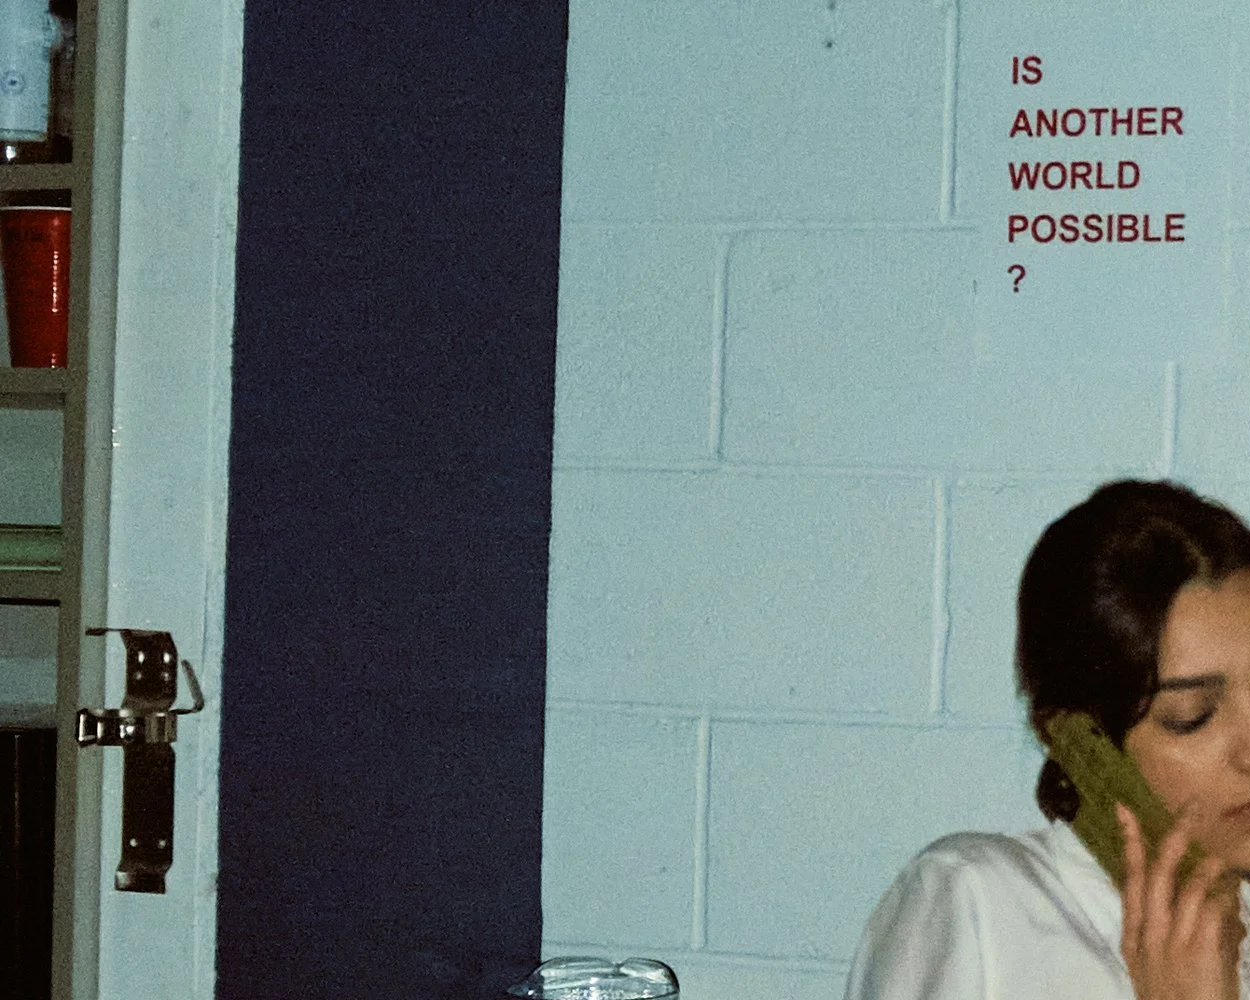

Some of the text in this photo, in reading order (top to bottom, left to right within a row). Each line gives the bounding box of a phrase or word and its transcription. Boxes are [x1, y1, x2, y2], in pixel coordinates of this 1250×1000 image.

[1011, 55, 1044, 86] IS
[1009, 106, 1185, 138] ANOTHER
[1008, 160, 1142, 191] WORLD
[1007, 213, 1186, 244] POSSIBLE
[1007, 264, 1027, 293] ?
